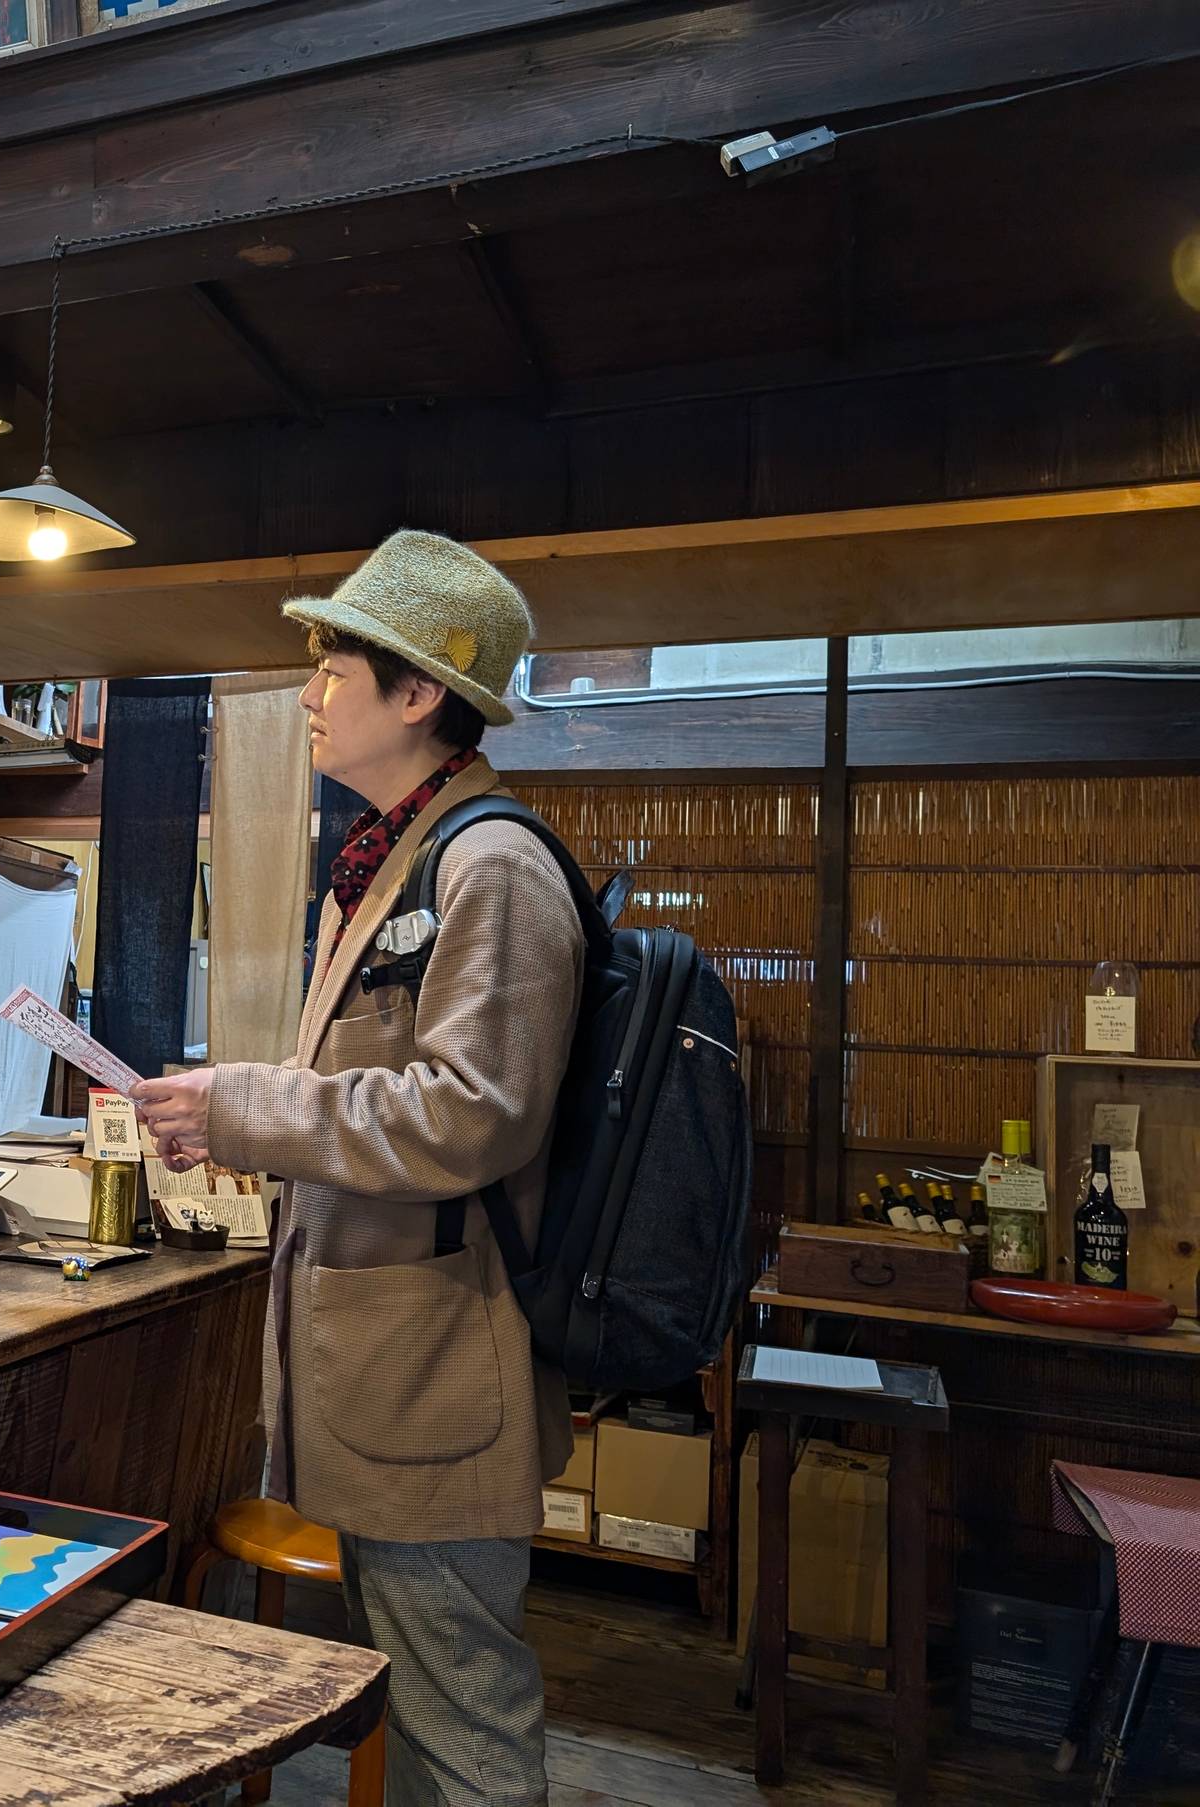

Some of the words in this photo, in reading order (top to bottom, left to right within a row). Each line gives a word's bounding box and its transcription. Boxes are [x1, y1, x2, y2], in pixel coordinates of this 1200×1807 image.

[105, 1099, 130, 1108] PayPay
[1077, 1221, 1127, 1234] MADEIRA
[1086, 1234, 1120, 1247] WINE
[1094, 1247, 1112, 1261] 10
